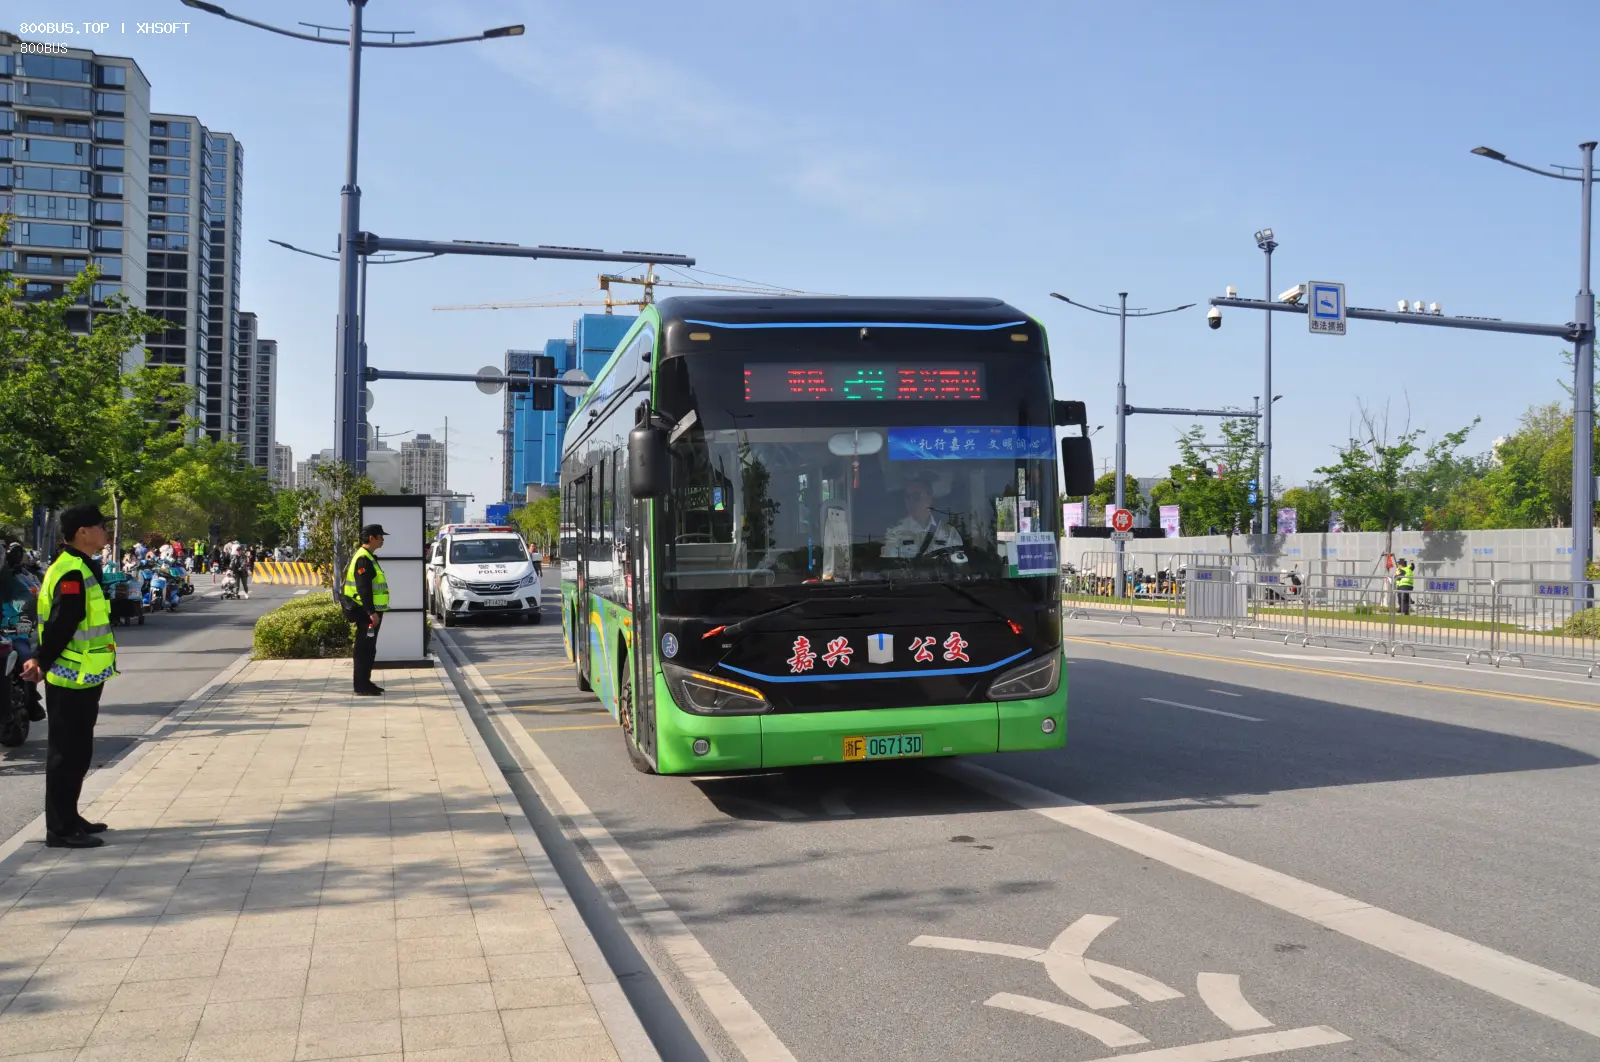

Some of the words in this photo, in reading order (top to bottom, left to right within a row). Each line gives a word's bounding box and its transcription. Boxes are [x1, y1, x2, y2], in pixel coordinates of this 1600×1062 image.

[1115, 513, 1129, 528] 停
[786, 635, 853, 673] 嘉兴
[908, 631, 970, 662] 公交
